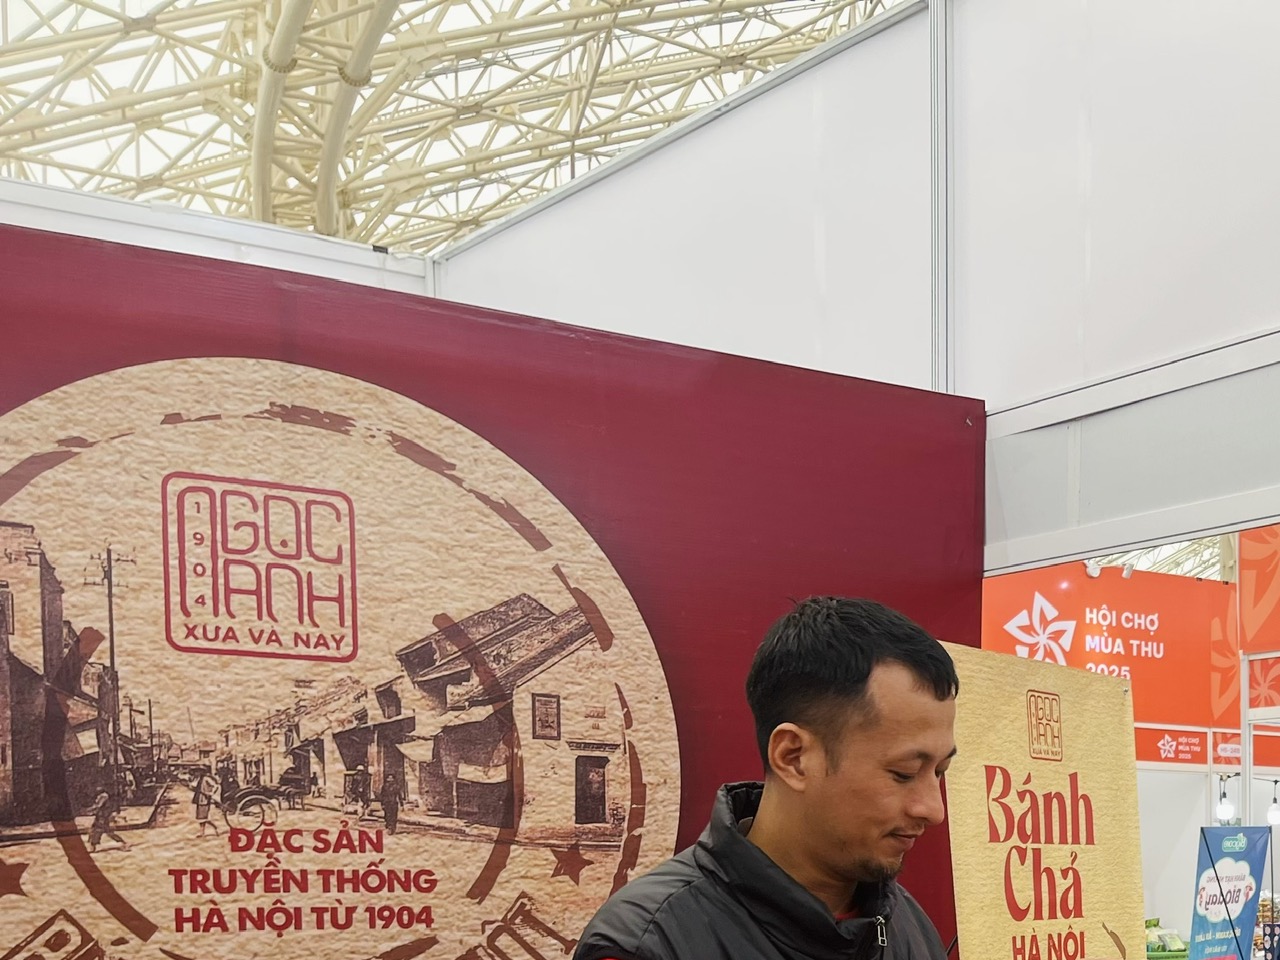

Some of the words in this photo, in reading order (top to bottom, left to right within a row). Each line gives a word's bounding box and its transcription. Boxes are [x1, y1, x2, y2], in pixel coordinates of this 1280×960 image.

[184, 623, 240, 644] XƯA
[248, 625, 284, 648] VÀ
[293, 632, 346, 651] NAY
[1085, 604, 1117, 631] HỘI
[1121, 612, 1160, 636] CHỢ
[1085, 632, 1126, 656] MÙA
[1130, 640, 1165, 659] THU
[983, 764, 1097, 846] Bánh
[228, 819, 304, 859] ĐẶC
[312, 819, 384, 854] SẢN
[168, 856, 309, 894] TRUYỀN
[316, 858, 438, 894] THỐNG
[1003, 845, 1085, 922] Chả
[174, 899, 229, 933] HÀ
[238, 898, 303, 938] NỘI
[311, 898, 358, 931] TỪ
[364, 905, 435, 930] 1904
